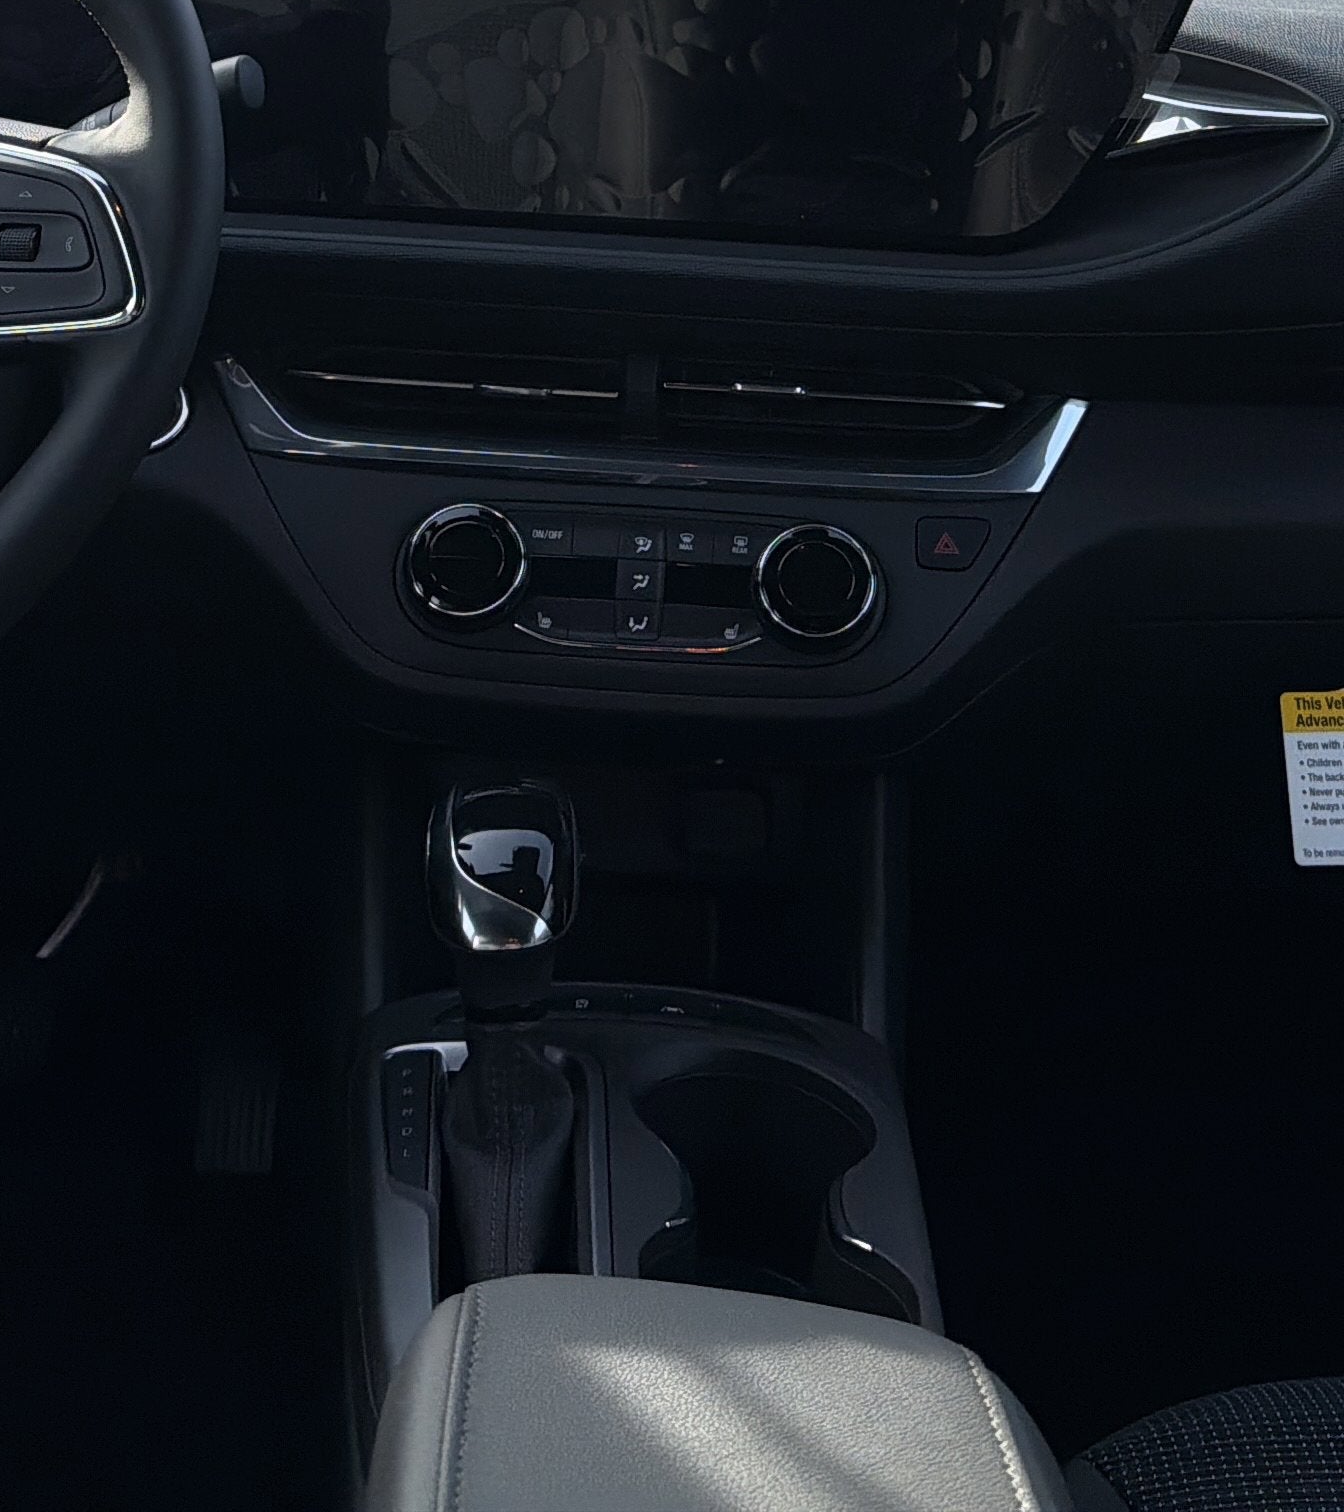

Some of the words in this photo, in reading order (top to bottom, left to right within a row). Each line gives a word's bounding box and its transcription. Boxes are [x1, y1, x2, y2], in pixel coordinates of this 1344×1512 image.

[532, 529, 563, 540] ON/OFF
[679, 543, 693, 551] MAX
[1295, 697, 1322, 710] This
[1298, 741, 1319, 749] Even
[1322, 741, 1340, 749] with
[1303, 849, 1312, 857] To
[1315, 849, 1324, 857] be
